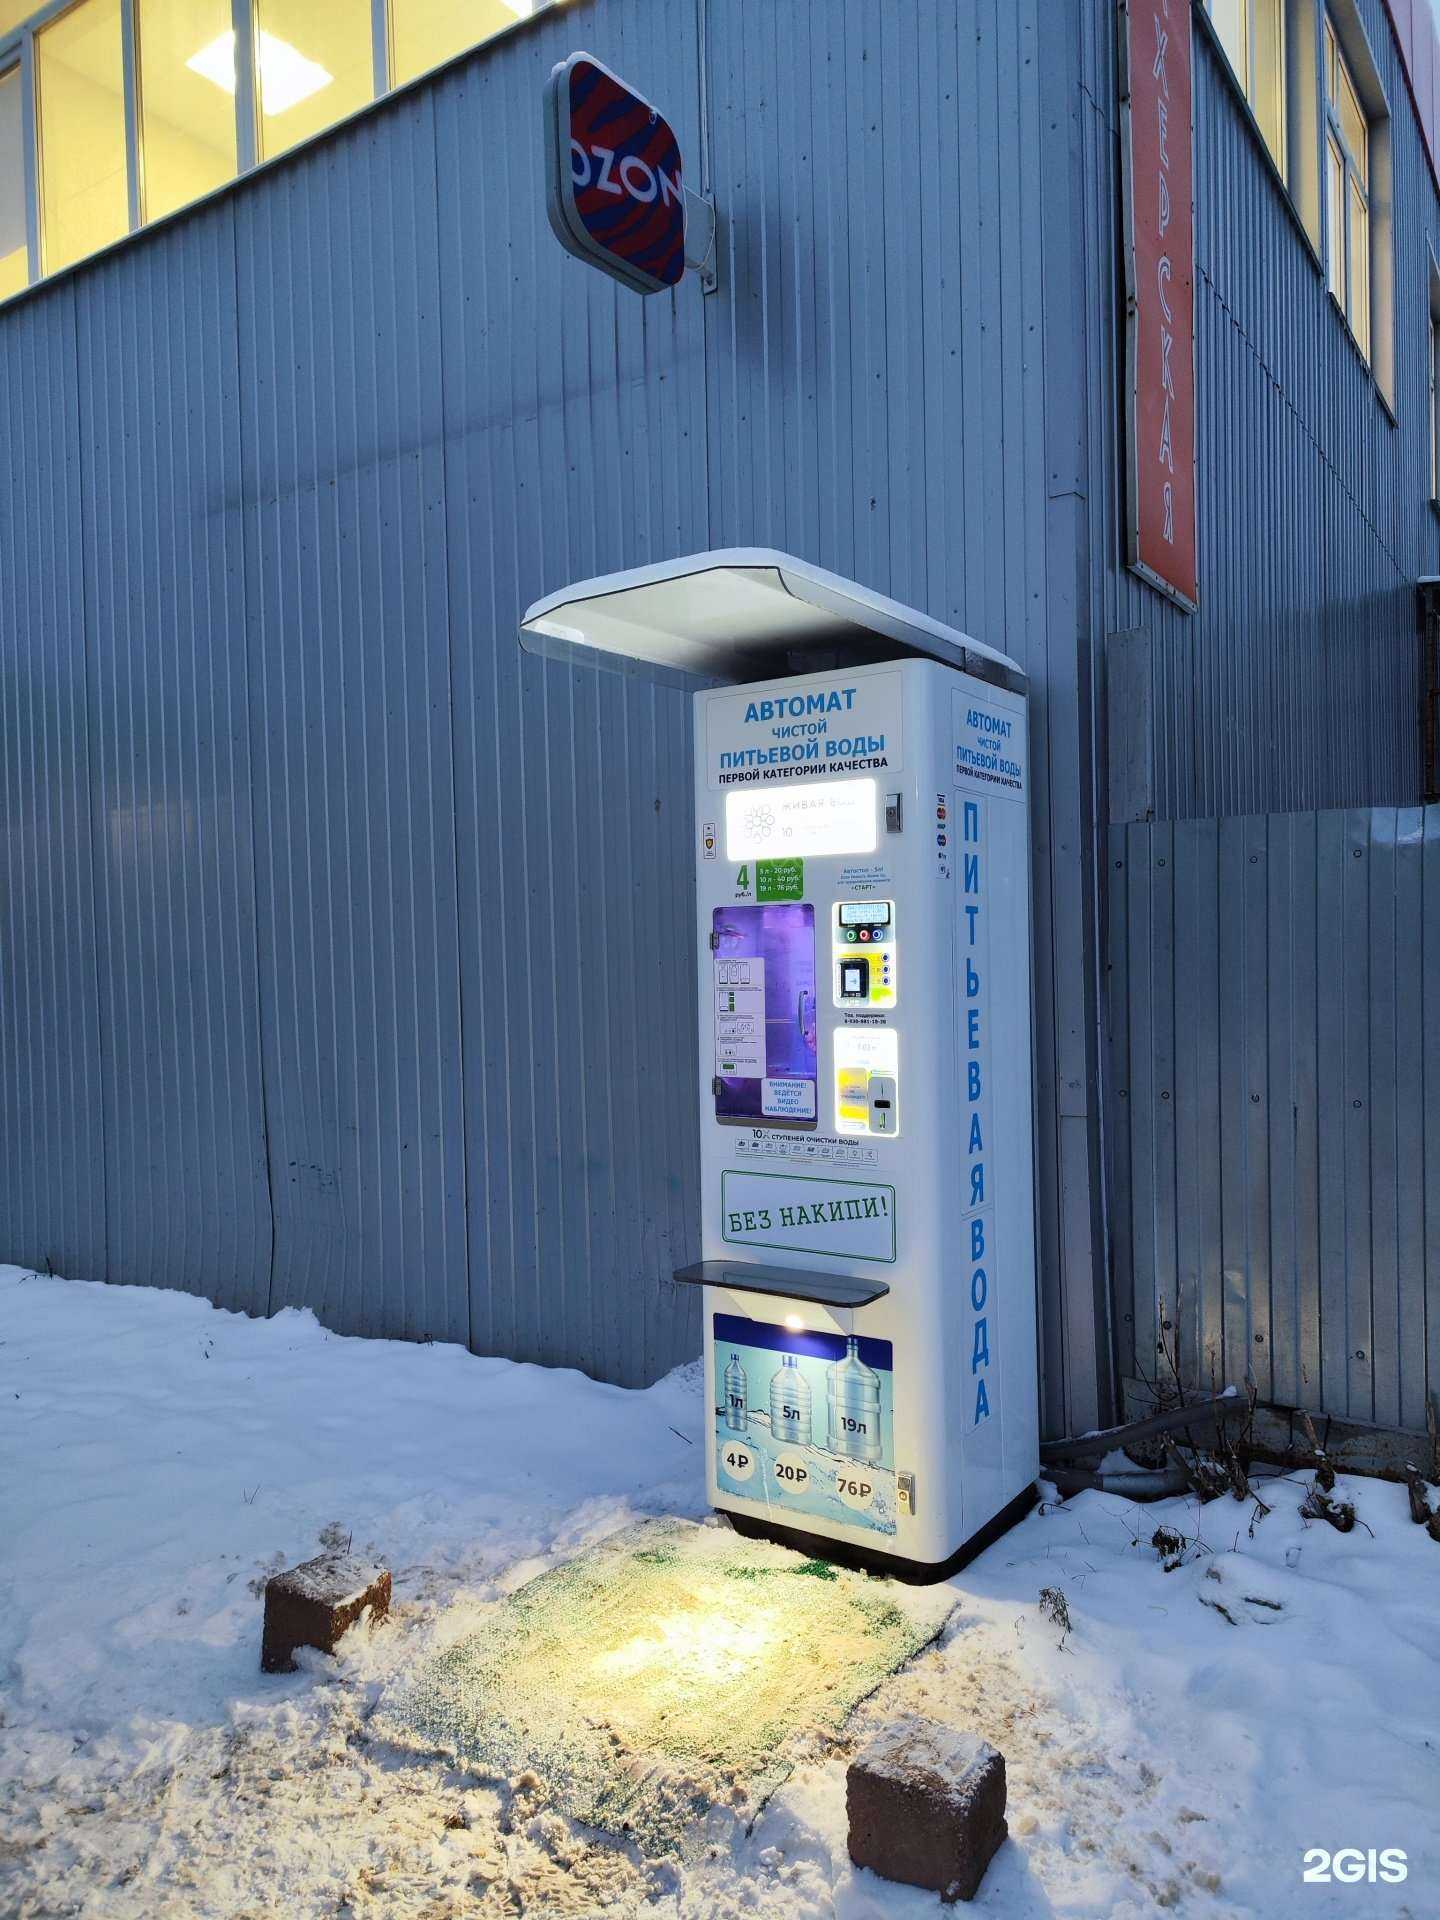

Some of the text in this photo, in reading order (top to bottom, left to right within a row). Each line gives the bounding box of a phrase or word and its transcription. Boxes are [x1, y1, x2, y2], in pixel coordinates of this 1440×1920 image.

[1152, 0, 1175, 544] ХЕРСКАЯ
[744, 688, 857, 723] АВТОМАТ
[966, 709, 1012, 738] АВТОМАТ
[720, 734, 885, 769] ПИТЬЕВОЙ ВОДЫ
[957, 746, 1022, 778] ПИТЬЕВОЙ ВОДЫ
[718, 757, 888, 784] ПЕРВОЙ КАТЕГОРИИ КАЧЕСТВА
[956, 764, 974, 776] ПЕРВОЙ
[974, 770, 1000, 784] КАТЕГОРИИ
[736, 864, 750, 890] 4
[772, 1134, 804, 1142] СТУПЕНЕЙ
[728, 1196, 888, 1232] БЕЗ НАКИПИ!
[783, 1406, 800, 1420] 5л
[841, 1417, 867, 1434] 19л
